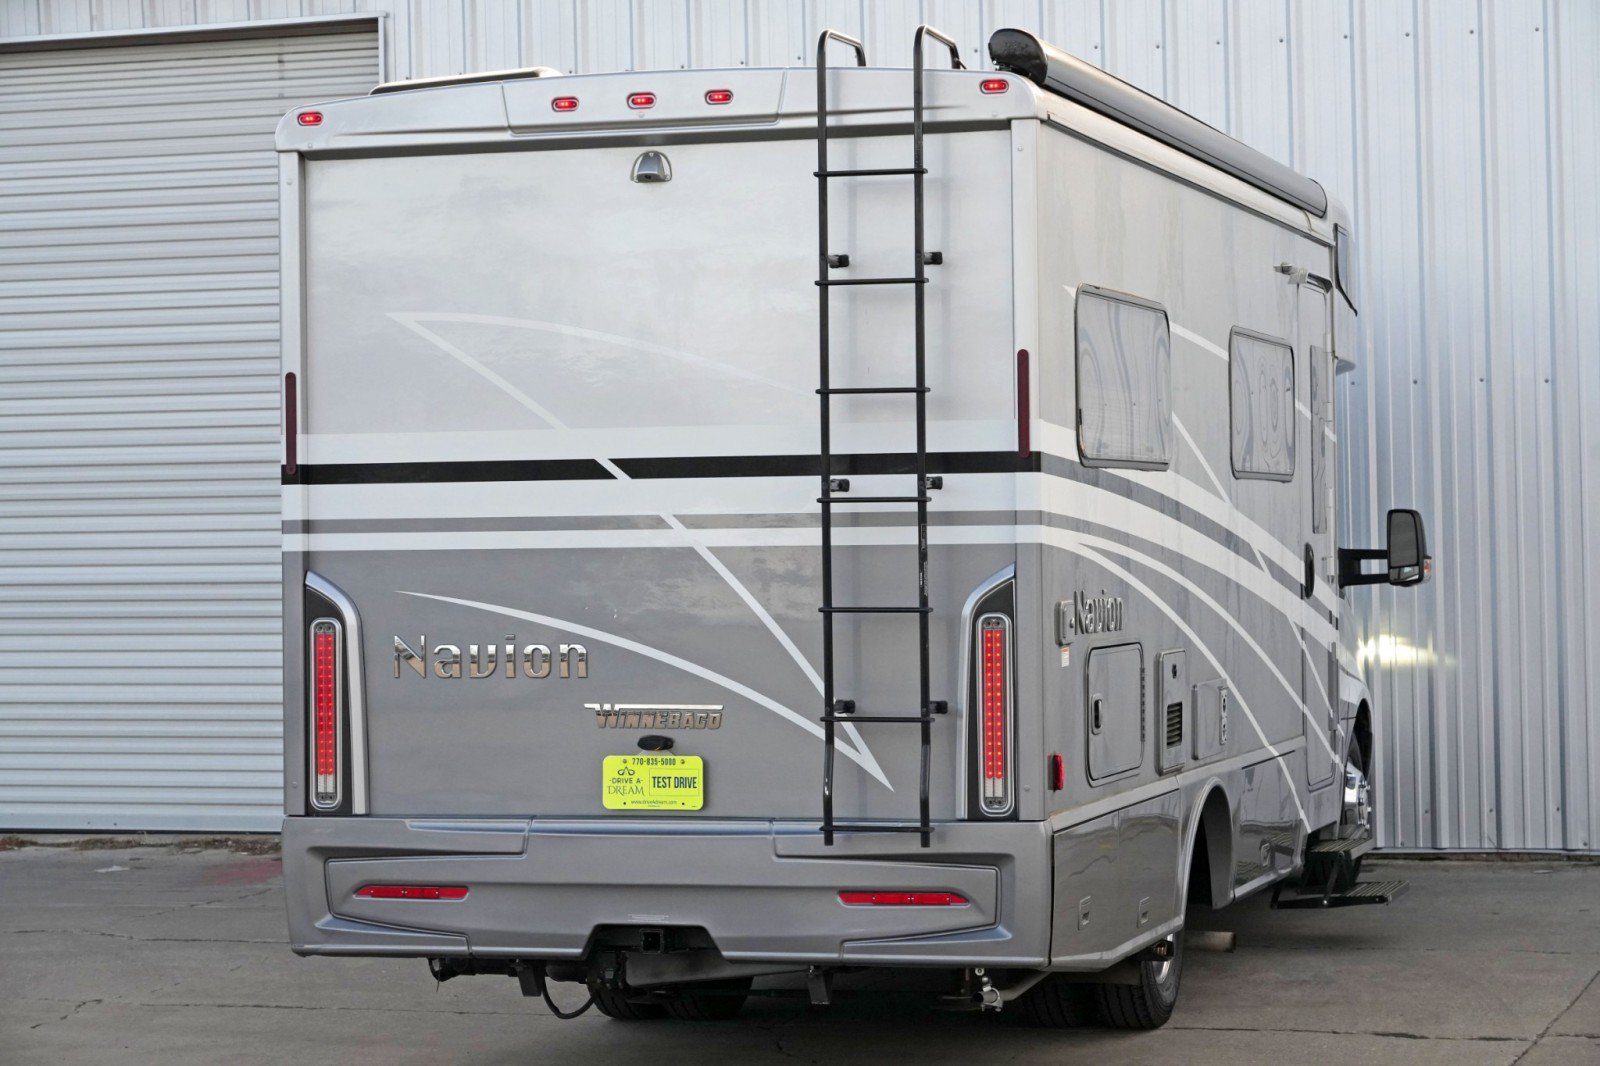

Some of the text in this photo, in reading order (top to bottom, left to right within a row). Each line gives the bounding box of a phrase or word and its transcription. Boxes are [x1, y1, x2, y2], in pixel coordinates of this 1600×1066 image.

[1073, 589, 1124, 635] Navion
[394, 634, 588, 678] Navion
[584, 703, 724, 729] WINNEBAGO
[632, 757, 677, 766] 770-835-5000
[608, 785, 645, 796] DREAM
[652, 776, 698, 789] TEST DRIVE
